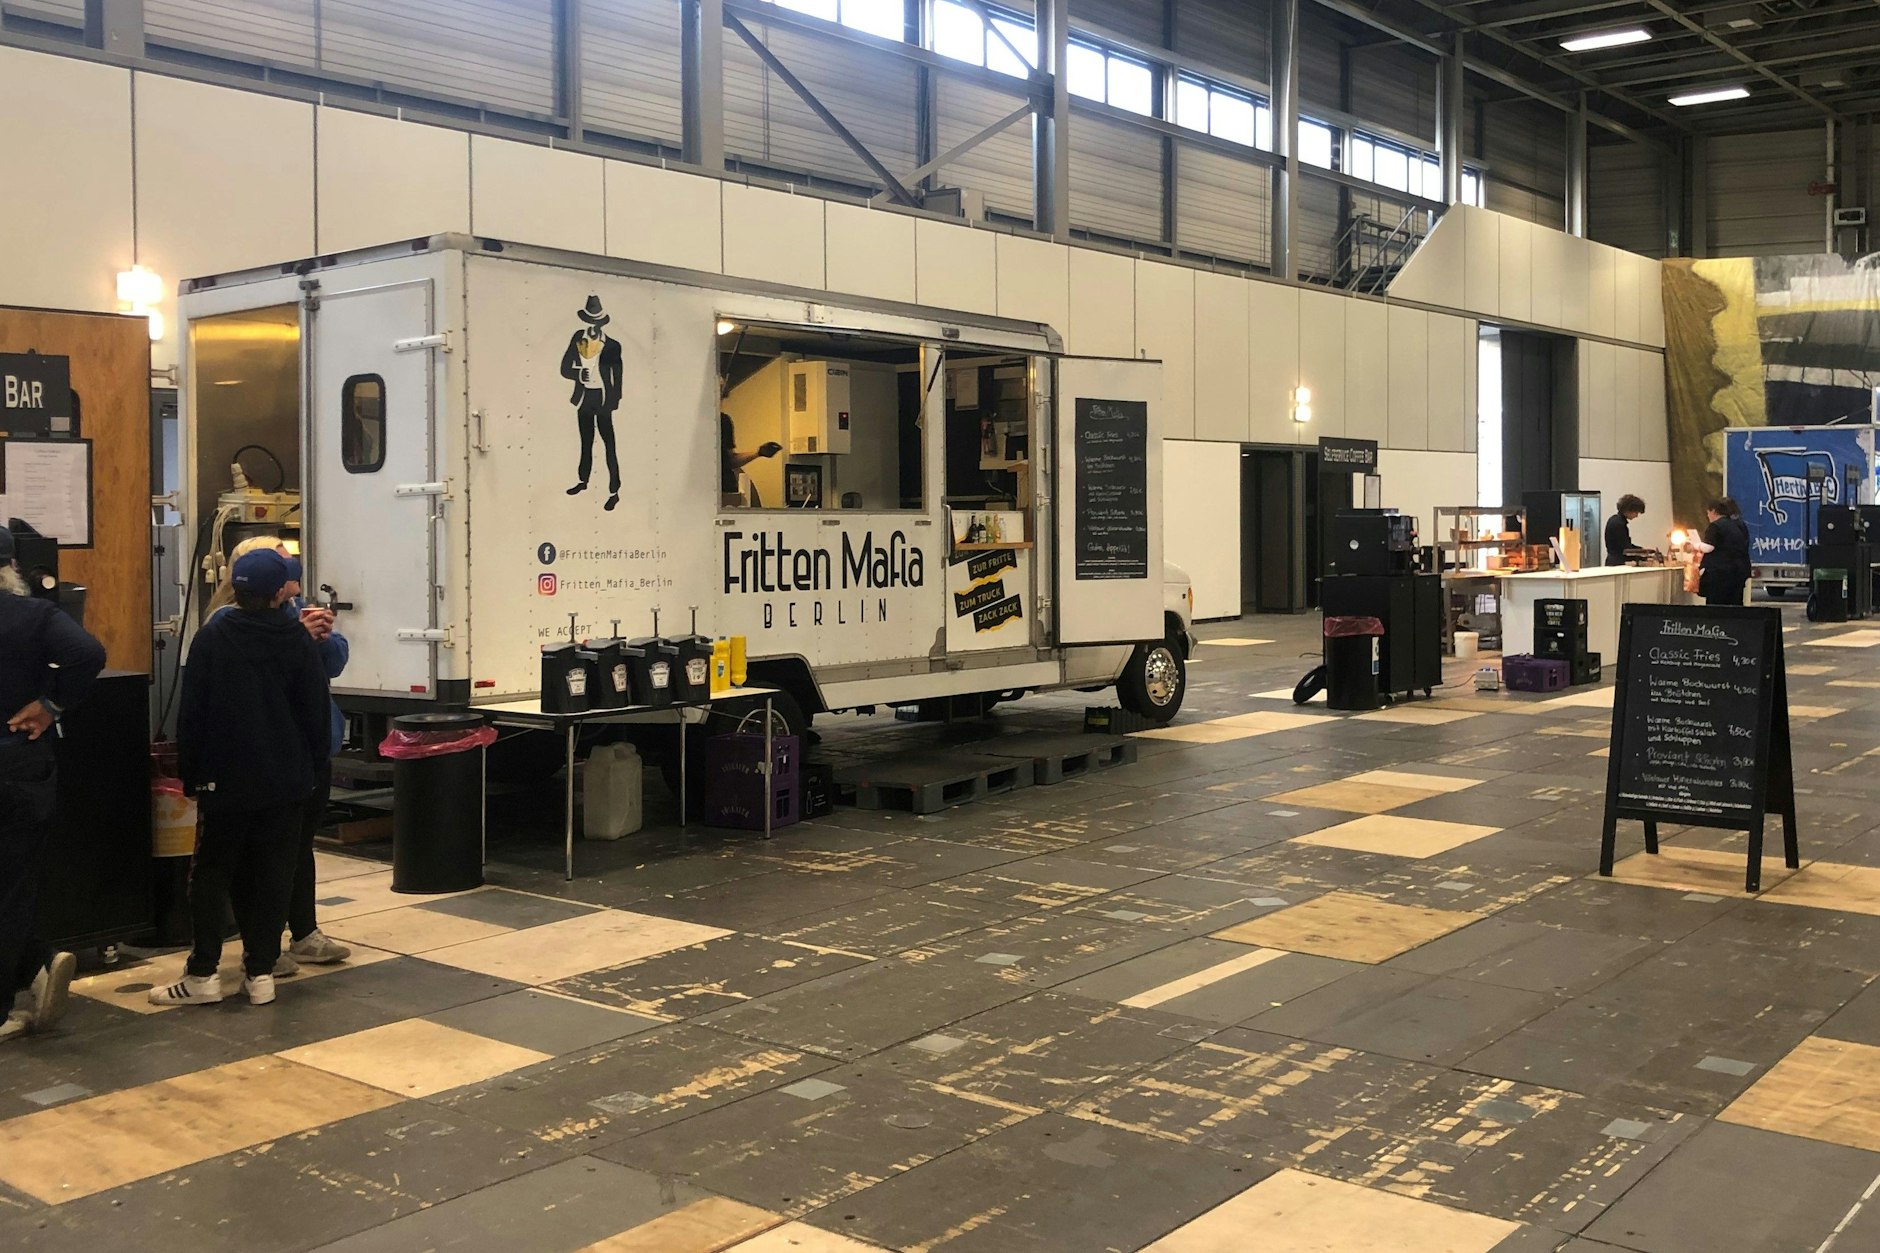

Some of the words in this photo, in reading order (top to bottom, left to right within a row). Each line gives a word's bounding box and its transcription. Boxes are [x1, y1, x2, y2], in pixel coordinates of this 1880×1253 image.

[4, 375, 43, 409] BAR
[1775, 479, 1813, 496] Herth
[559, 550, 667, 560] @FrittenMafiaBerlin
[724, 531, 831, 594] Fritten
[842, 530, 924, 589] Mafia
[972, 562, 987, 574] ZUR
[988, 552, 1012, 568] FRITTE
[560, 578, 673, 592] Fritten_Mafia_Berlin
[960, 598, 976, 611] ZUM
[977, 588, 1002, 603] TRUCK
[764, 598, 887, 629] BERLIN
[979, 610, 998, 624] ZACK
[999, 602, 1018, 615] ZACK
[538, 628, 550, 638] WE
[1649, 646, 1690, 661] Classic
[1694, 648, 1721, 662] Fries
[1649, 674, 1679, 687] Warme
[1682, 678, 1731, 690] Bockwurst
